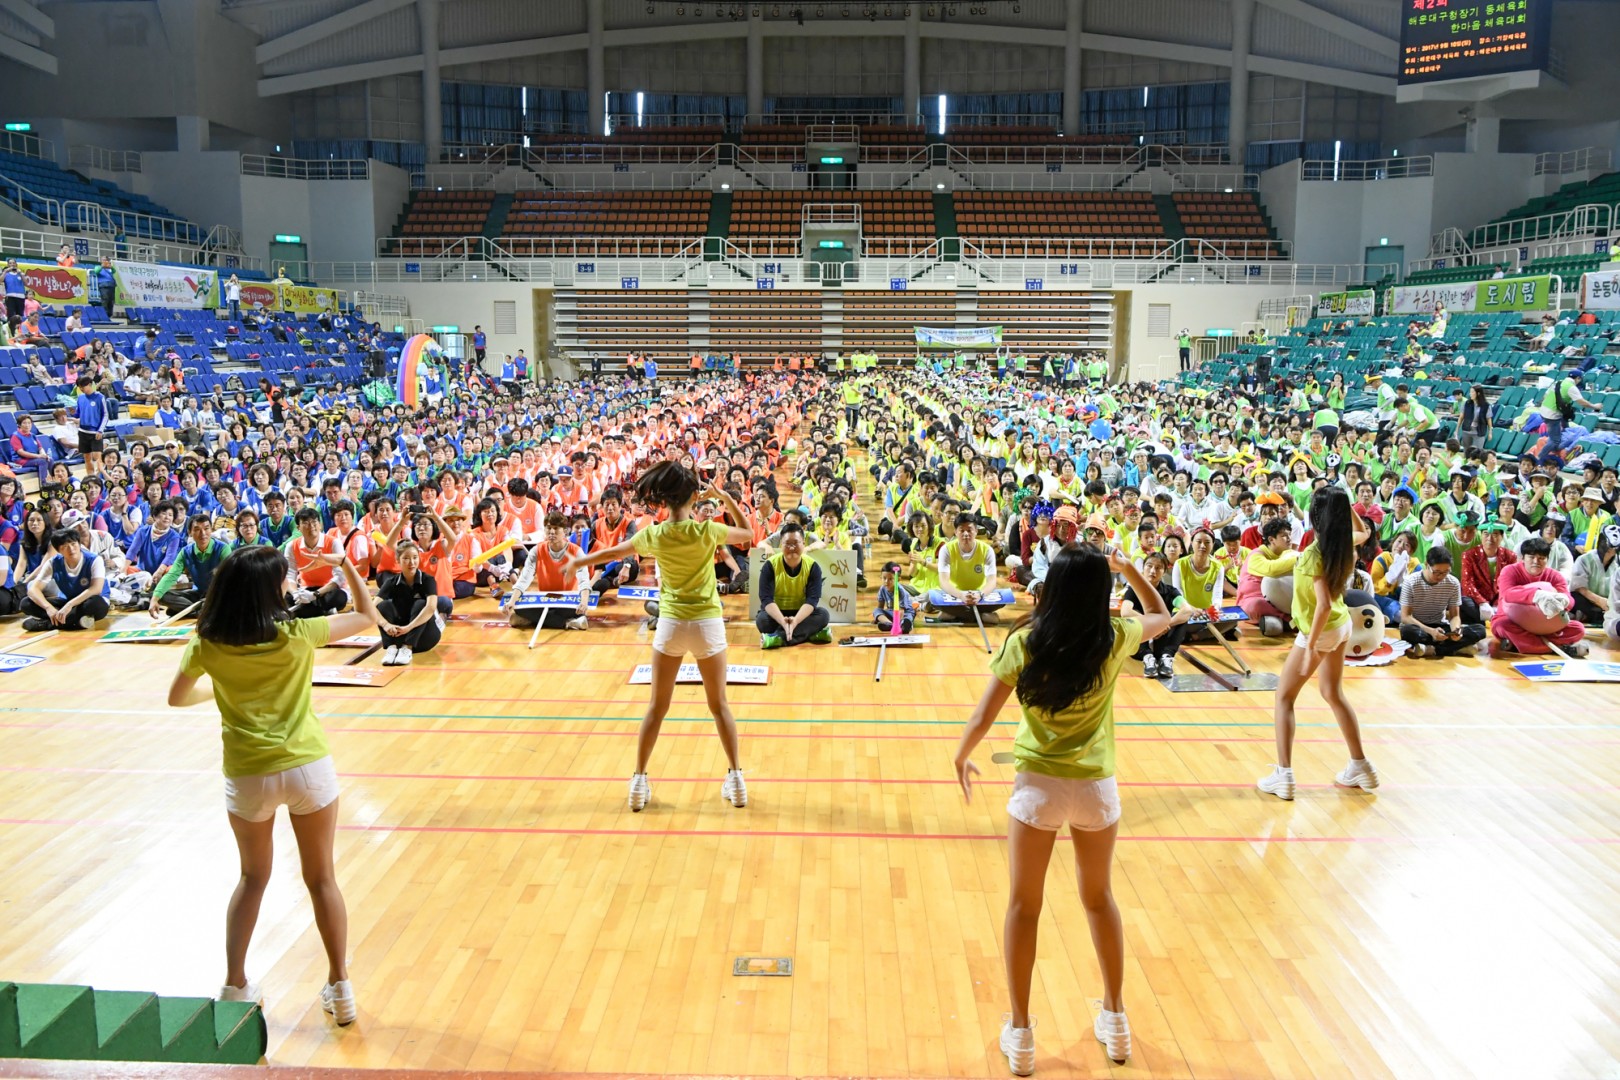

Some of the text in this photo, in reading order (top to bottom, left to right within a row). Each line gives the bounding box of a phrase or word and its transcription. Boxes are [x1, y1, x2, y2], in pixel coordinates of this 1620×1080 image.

[1408, 0, 1527, 25] 해운대구청장기 동체육회
[1451, 13, 1526, 33] 한마음 체육대회
[76, 245, 87, 255] 2-5
[1485, 280, 1536, 305] 도시팀
